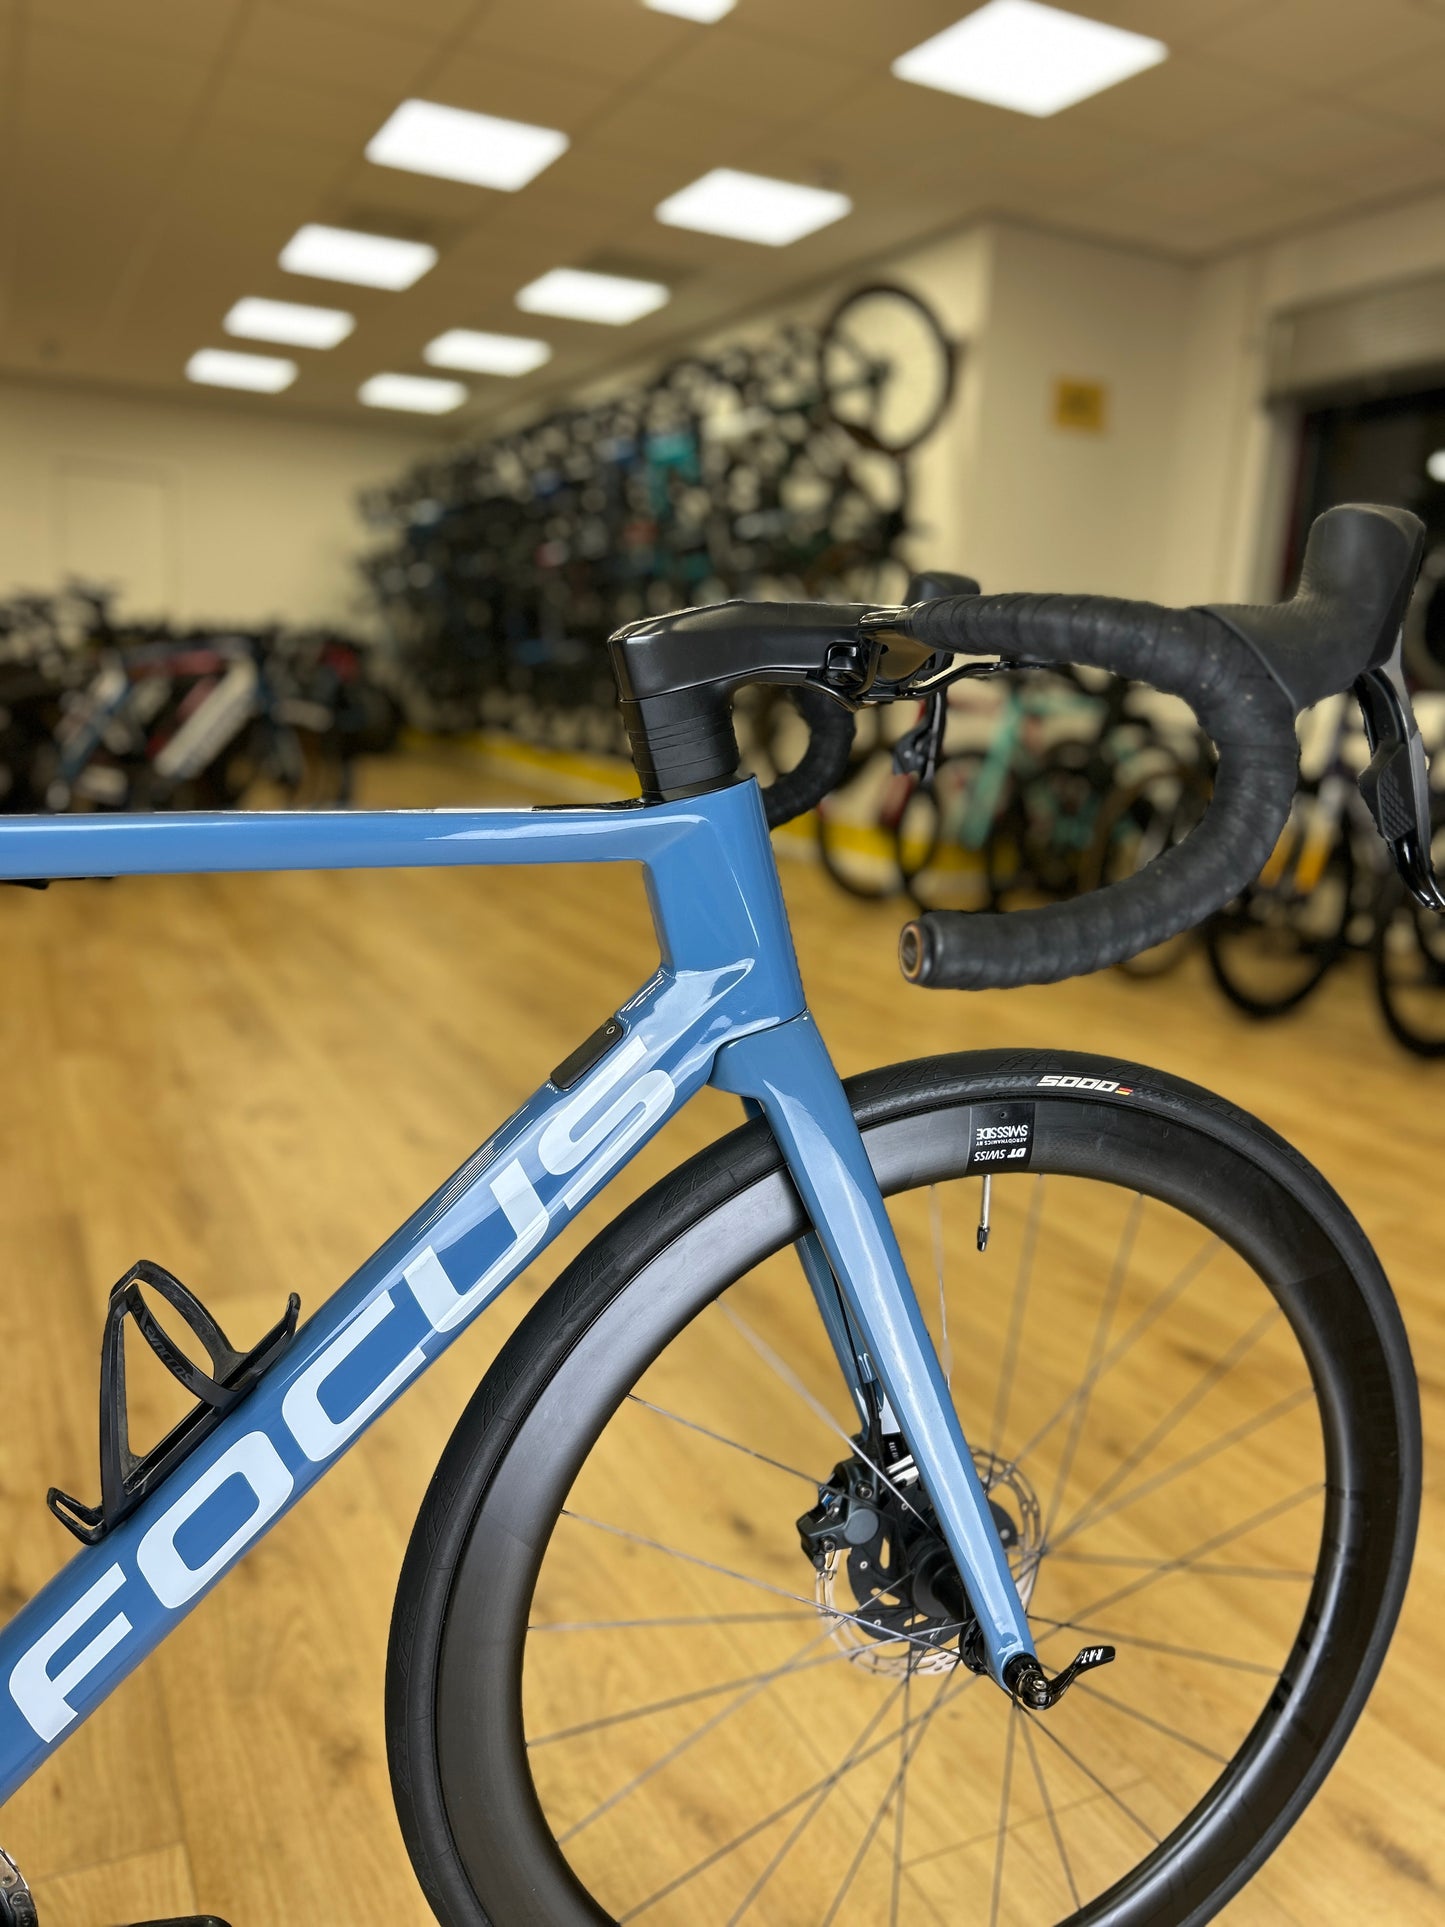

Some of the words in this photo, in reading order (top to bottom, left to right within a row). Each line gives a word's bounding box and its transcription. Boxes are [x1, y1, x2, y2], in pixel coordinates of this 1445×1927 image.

[1036, 1075, 1120, 1093] 5000
[973, 1150, 1005, 1162] SWISS
[1007, 1147, 1027, 1159] DT
[8, 1036, 676, 1744] FOCUS
